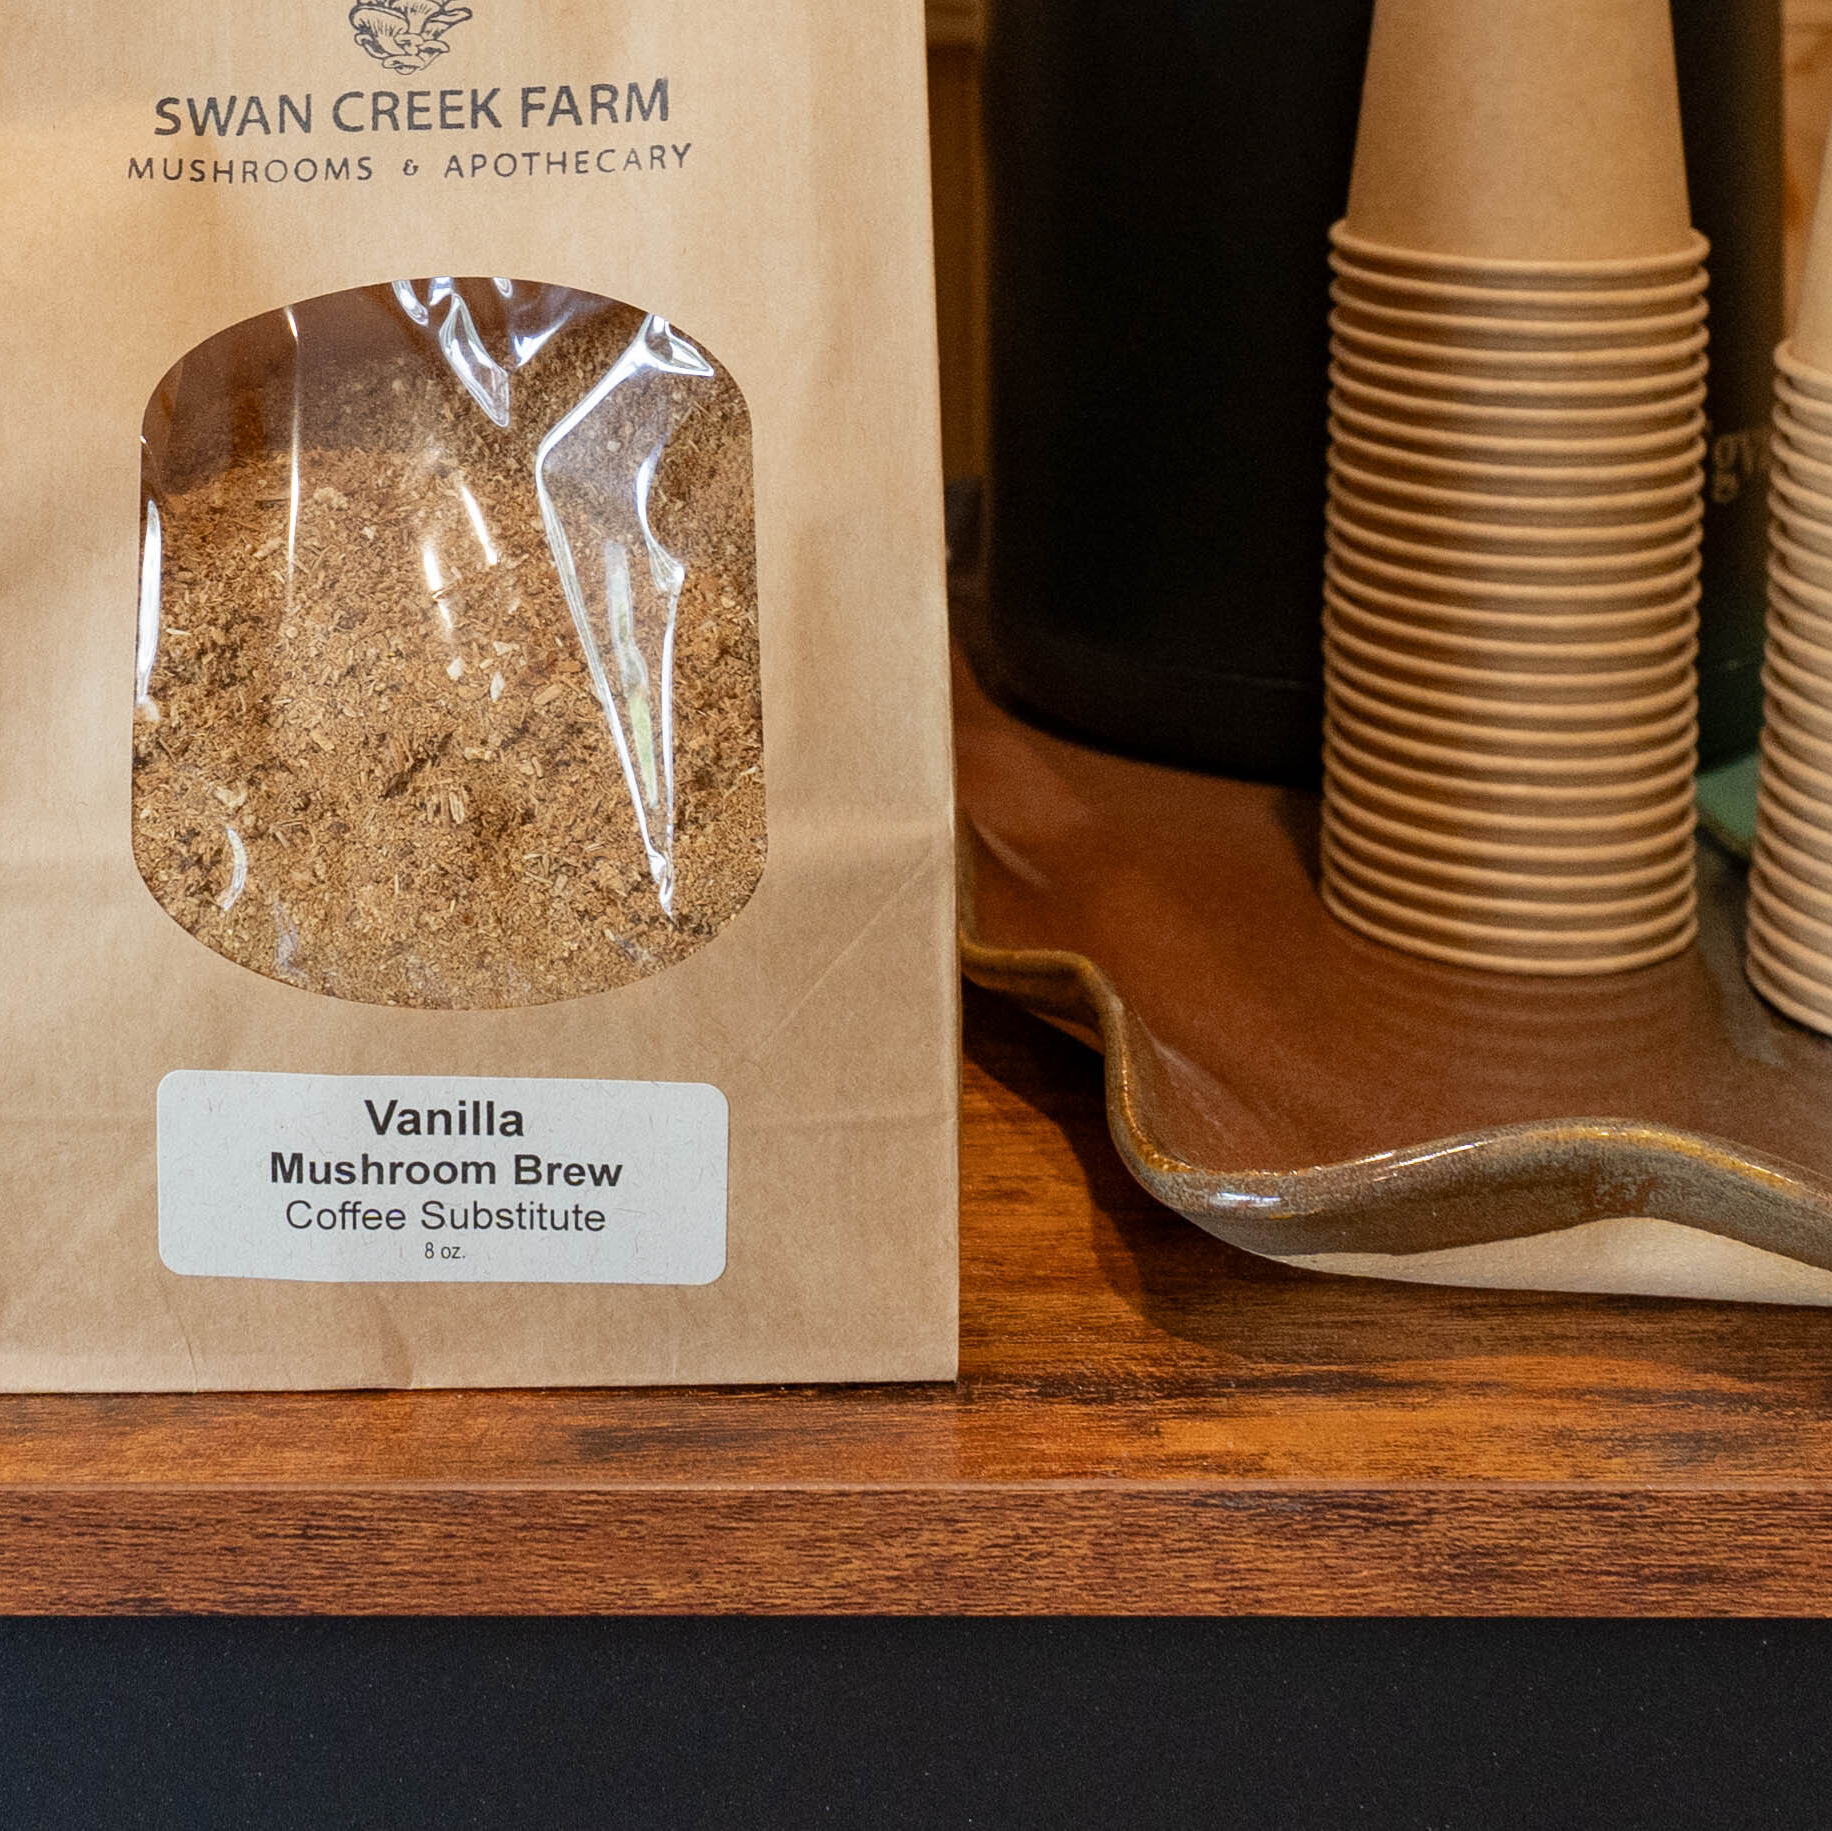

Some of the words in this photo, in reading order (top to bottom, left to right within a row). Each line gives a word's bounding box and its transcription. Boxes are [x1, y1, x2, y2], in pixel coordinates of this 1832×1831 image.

[153, 92, 313, 139] SWAN
[331, 86, 503, 134] CREEK
[520, 77, 670, 129] FARM
[127, 155, 374, 185] MUSHROOMS
[401, 158, 420, 177] &
[443, 142, 693, 179] APOTHECARY
[363, 1098, 525, 1139] Vanilla
[270, 1150, 497, 1186] Mushroom
[513, 1153, 624, 1188] Brew
[285, 1198, 407, 1232] Coffee
[420, 1199, 607, 1233] Substitute
[423, 1240, 436, 1260] 8
[439, 1245, 466, 1260] oz.
